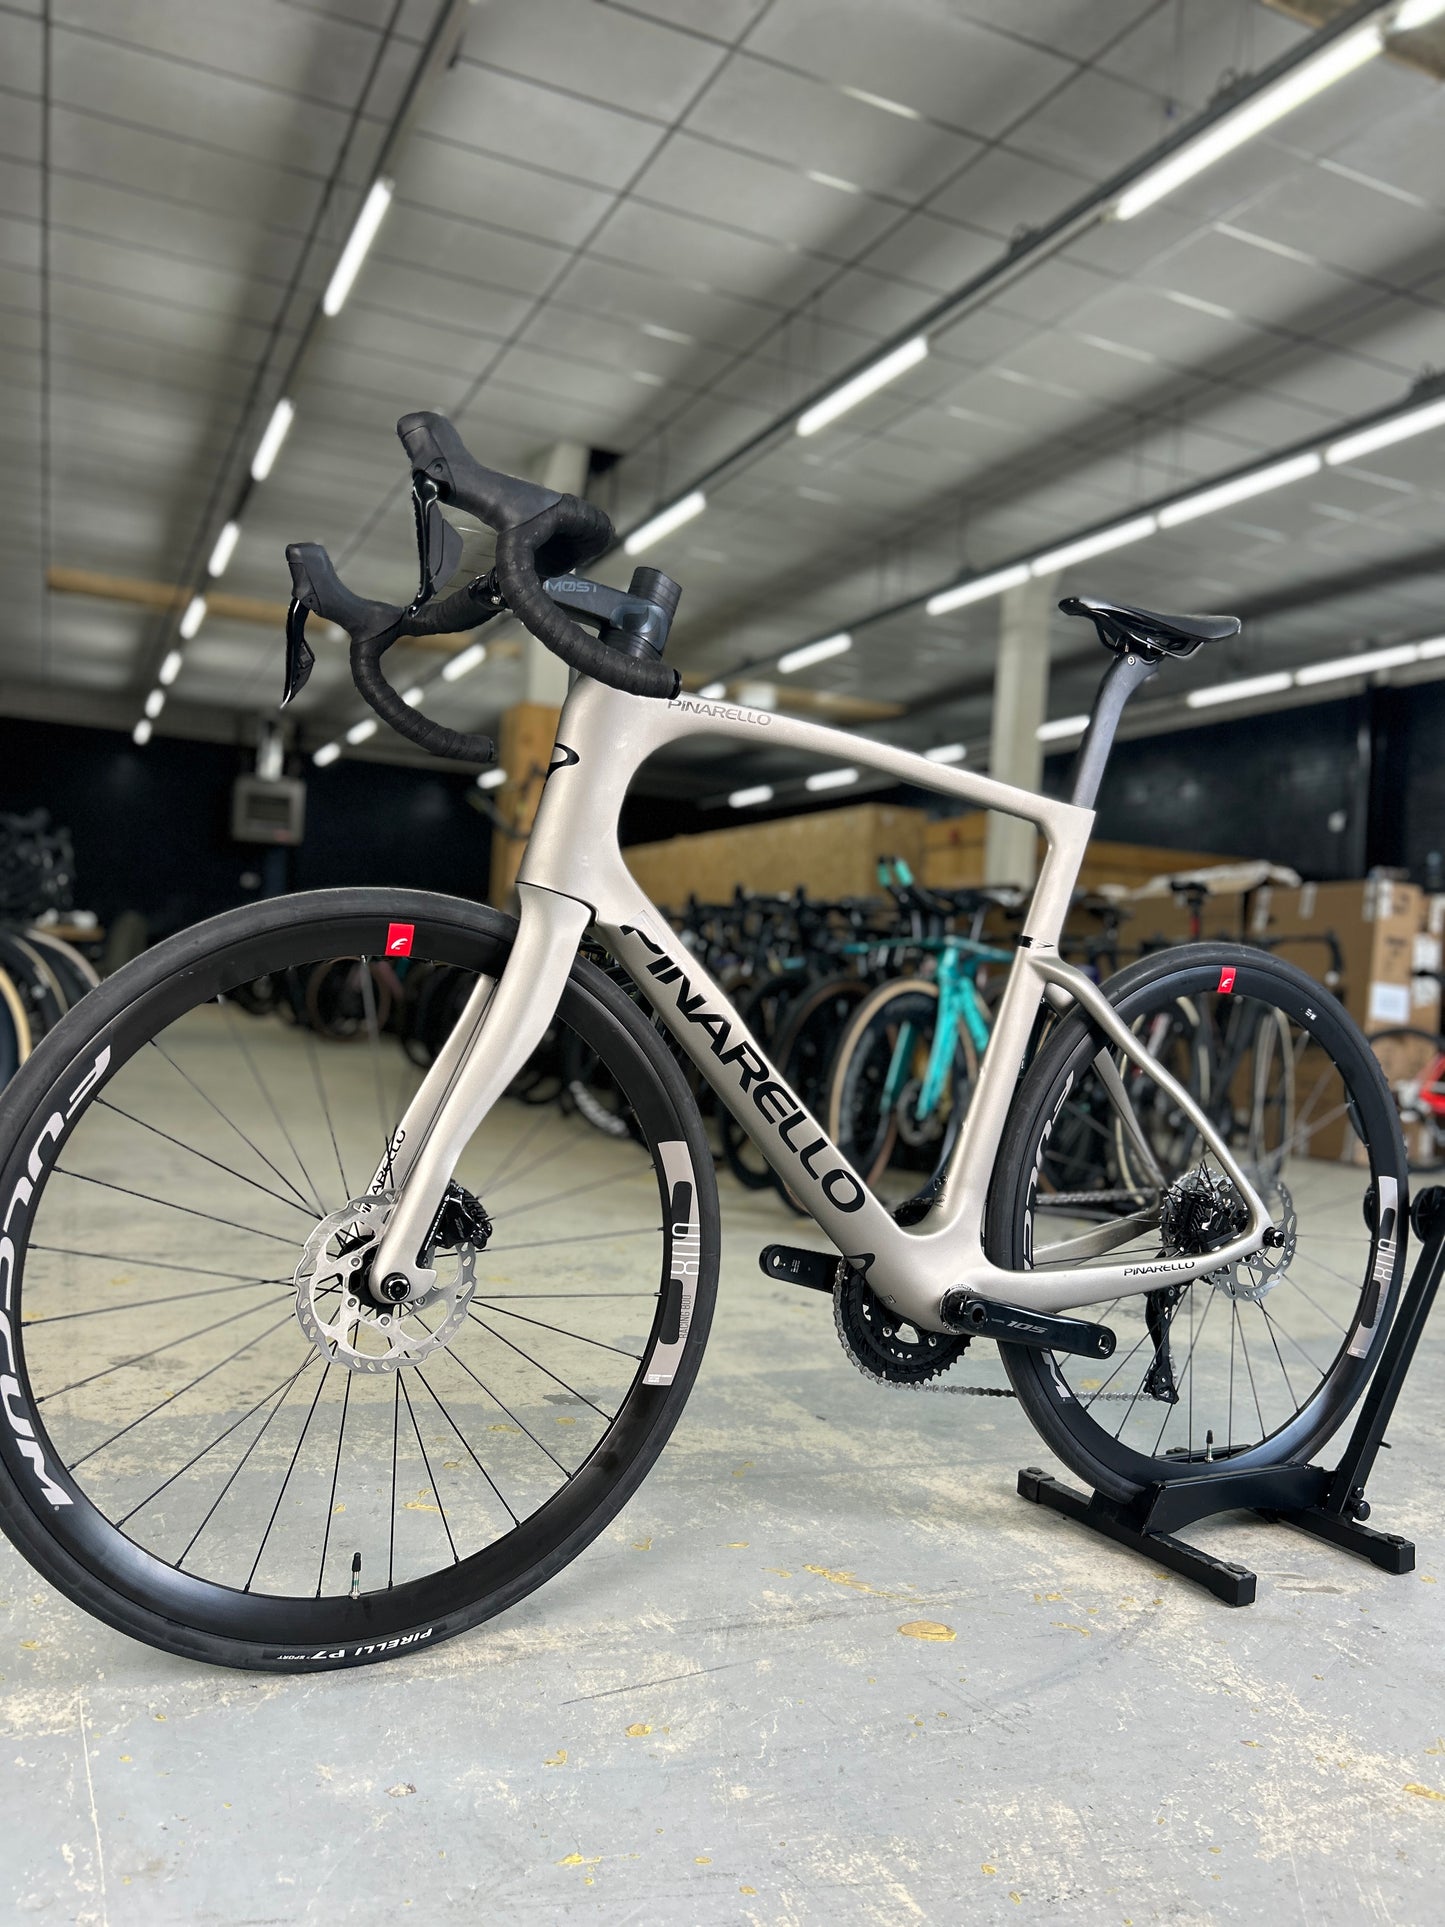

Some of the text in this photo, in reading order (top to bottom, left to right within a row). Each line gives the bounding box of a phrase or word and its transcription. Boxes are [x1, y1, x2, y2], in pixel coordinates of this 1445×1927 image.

[667, 700, 772, 726] PINARELLO
[619, 924, 866, 1213] PINARELLO
[1123, 1261, 1196, 1277] PINARELLO
[1005, 1320, 1048, 1334] 105
[355, 1628, 433, 1655] PIRELLI
[311, 1649, 345, 1660] P7
